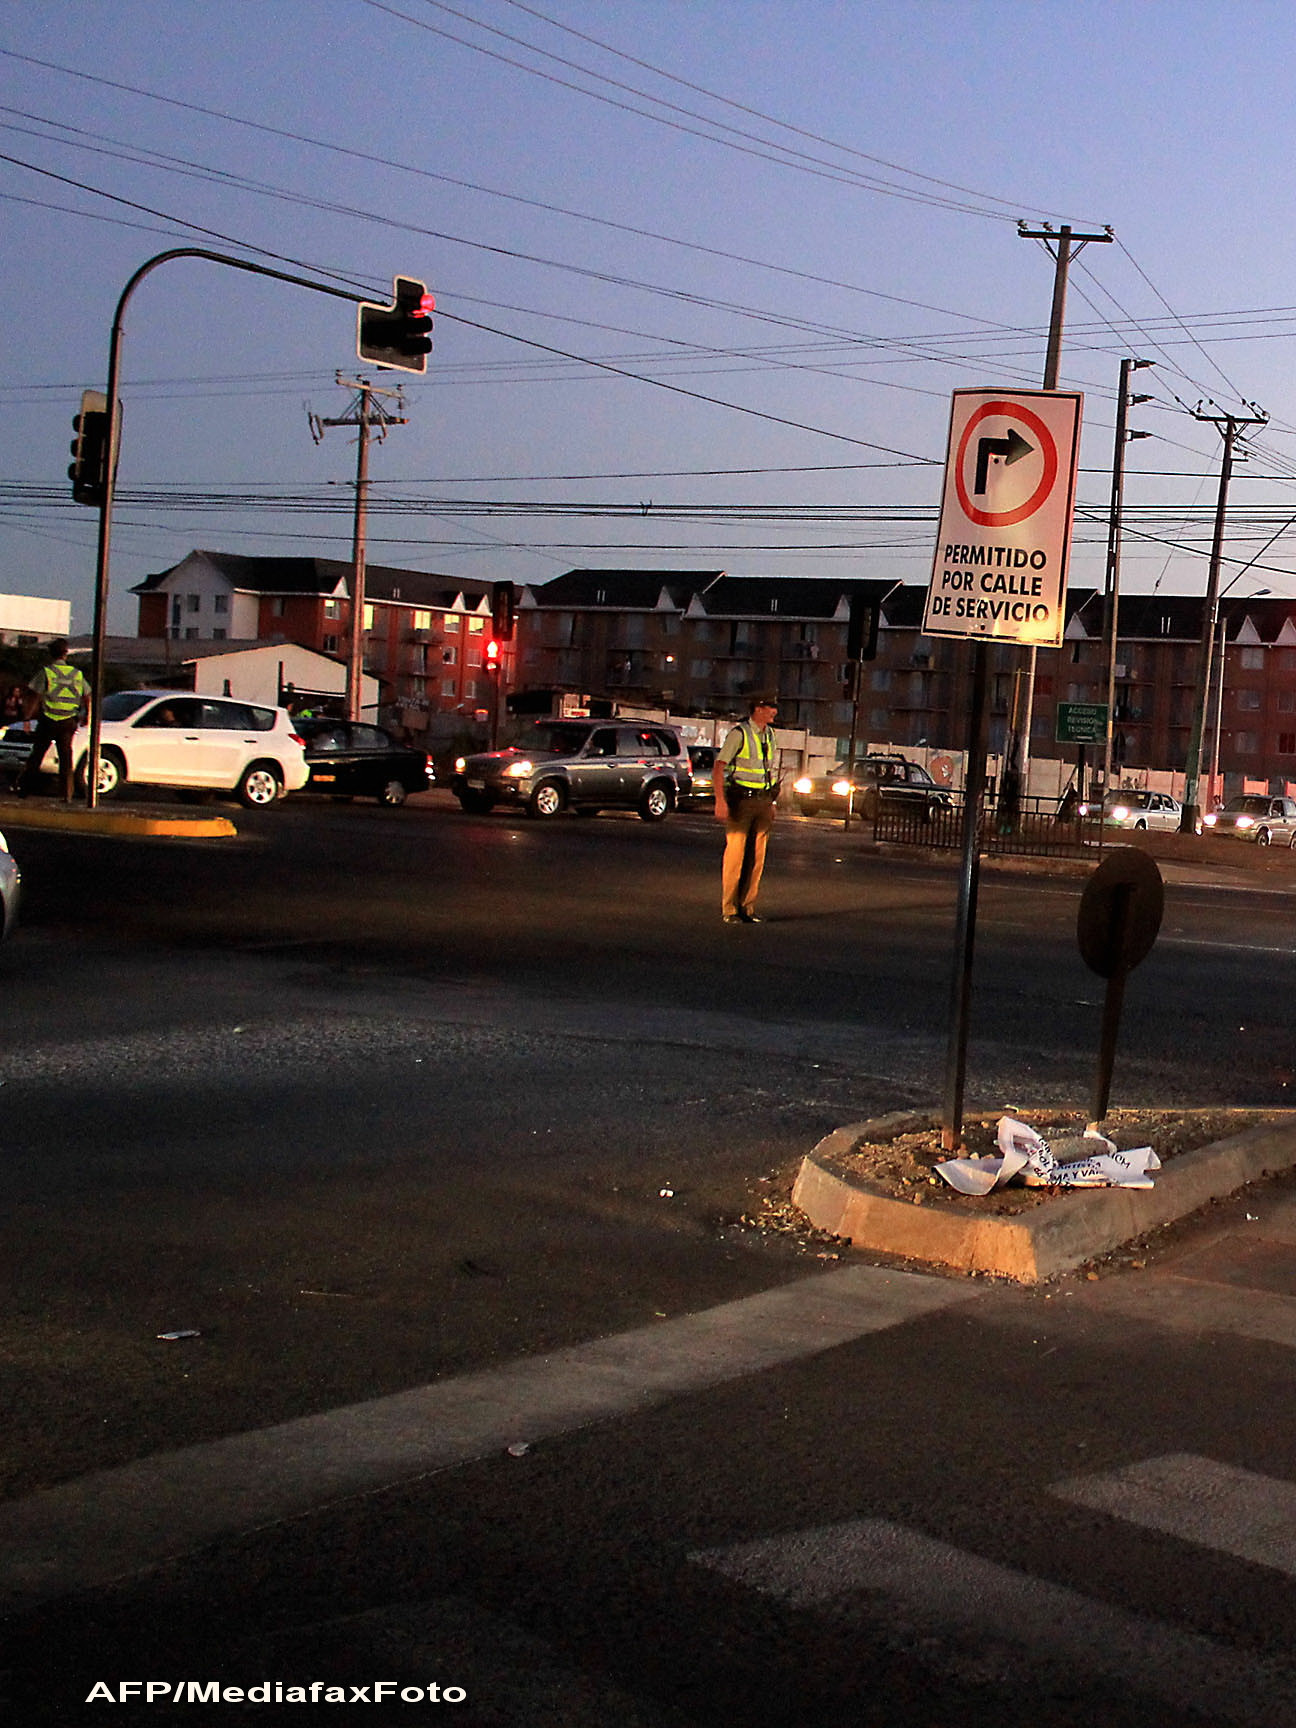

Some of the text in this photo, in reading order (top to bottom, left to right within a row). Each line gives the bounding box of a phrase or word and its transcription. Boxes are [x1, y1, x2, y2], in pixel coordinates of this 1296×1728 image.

[944, 545, 1047, 570] PERMITIDO
[942, 570, 1043, 597] POR CALLE
[932, 596, 1050, 623] DE SERVICIO
